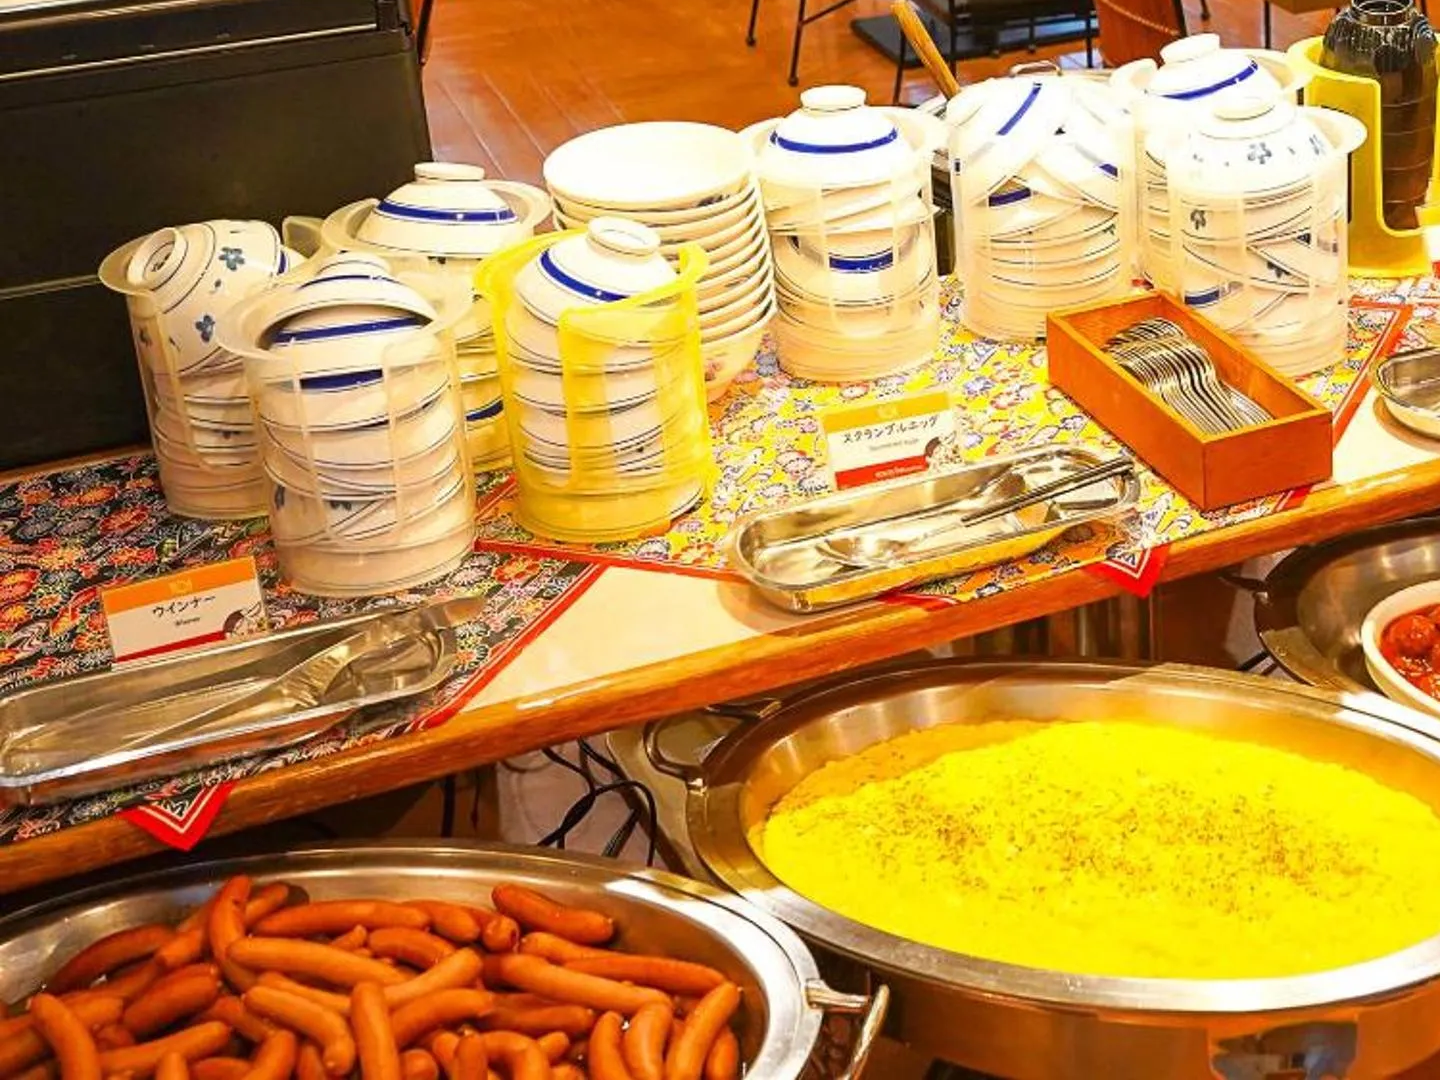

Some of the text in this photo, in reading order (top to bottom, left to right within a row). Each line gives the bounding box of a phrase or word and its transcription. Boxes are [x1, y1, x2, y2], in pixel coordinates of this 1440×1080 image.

[844, 415, 938, 444] スクランブルエッグ
